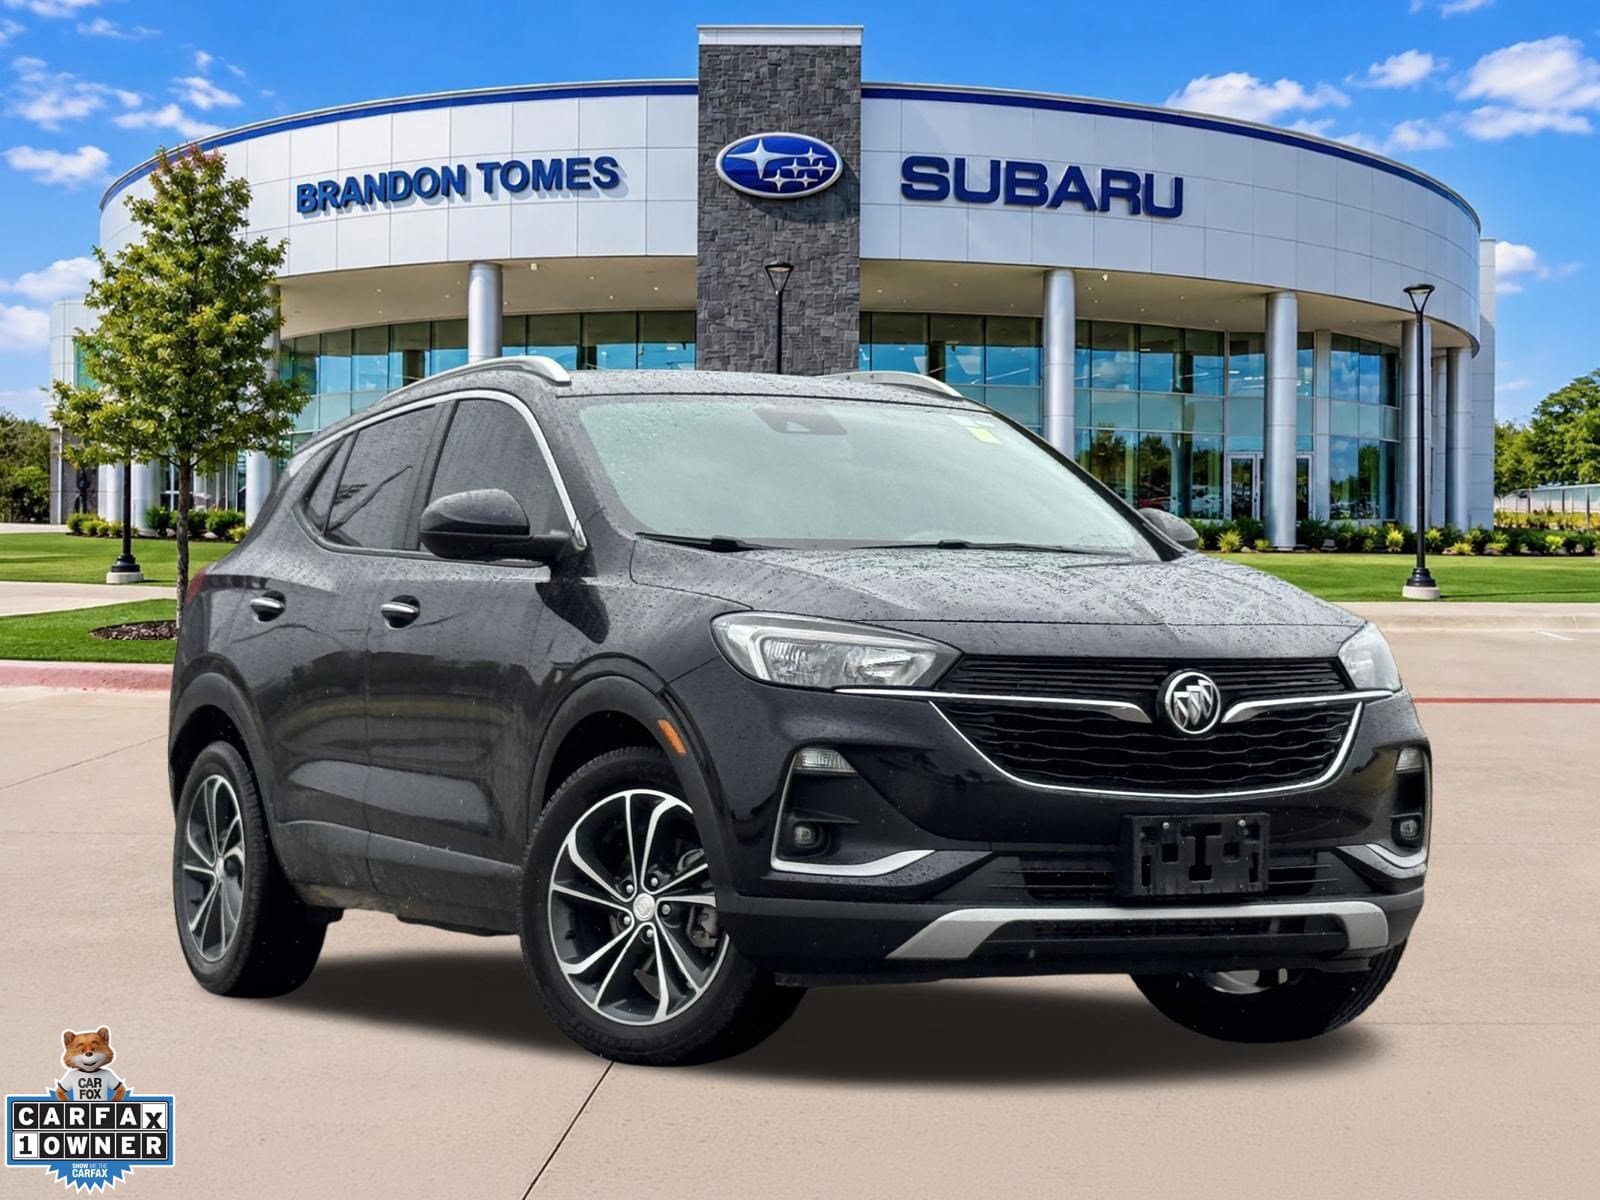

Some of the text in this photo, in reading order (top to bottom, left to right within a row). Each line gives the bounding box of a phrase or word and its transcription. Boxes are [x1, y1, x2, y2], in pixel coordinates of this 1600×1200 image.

[297, 156, 621, 213] BRANDON TOMES
[901, 155, 1184, 218] SUBARU
